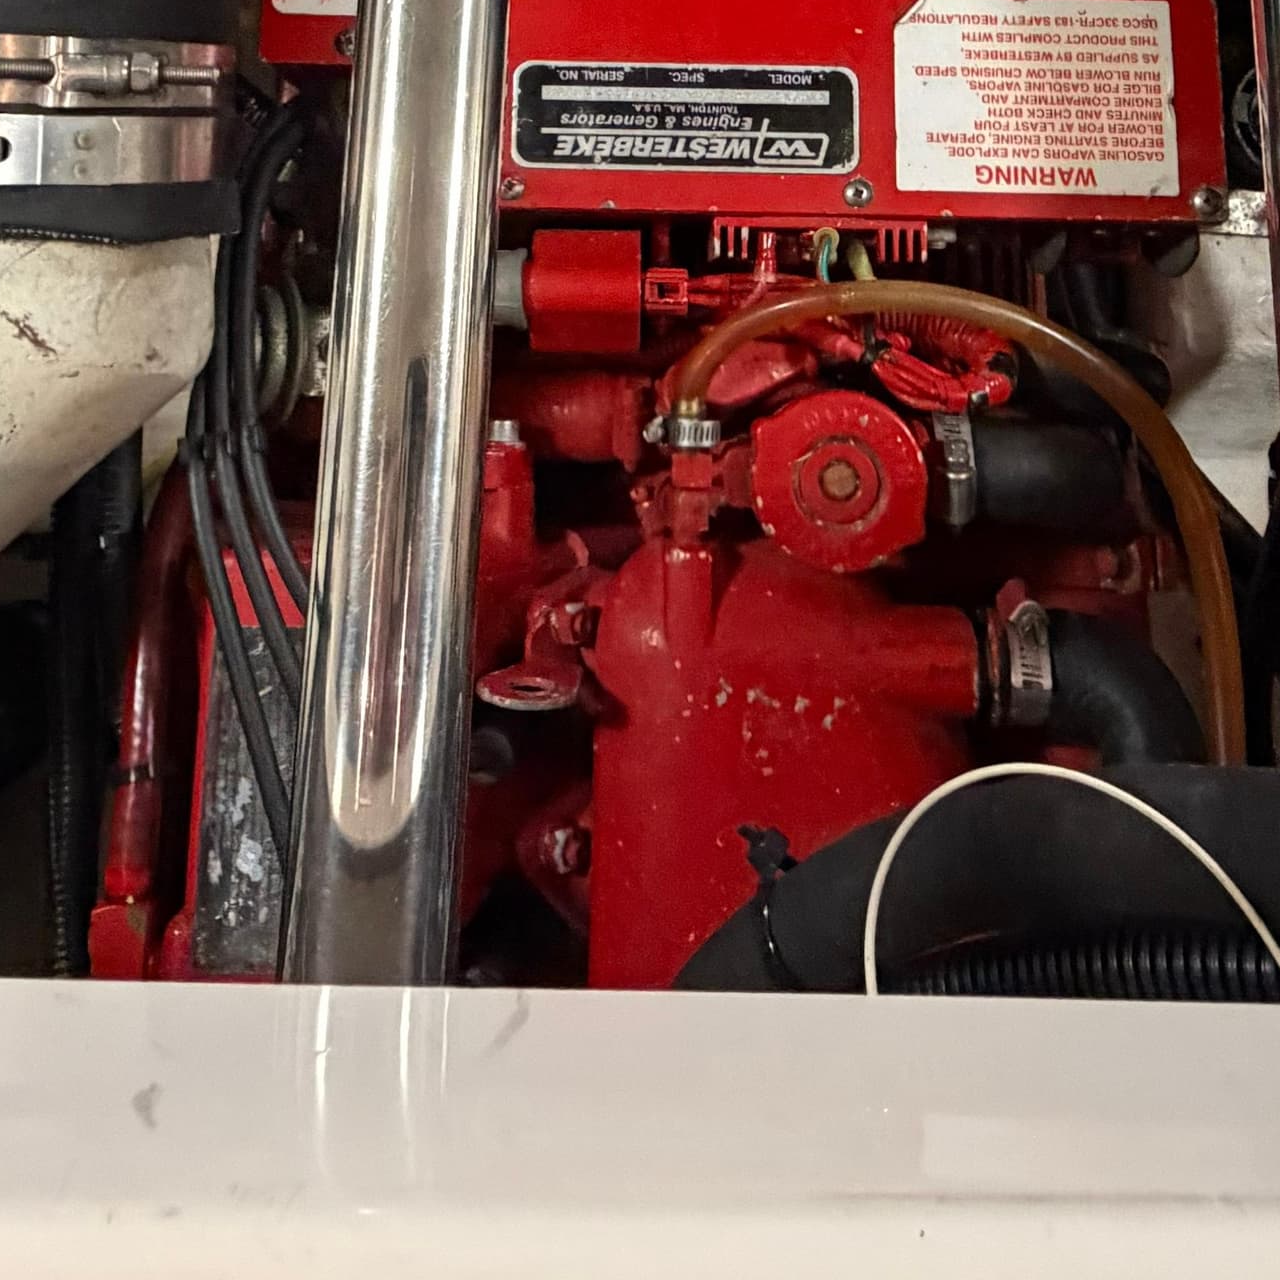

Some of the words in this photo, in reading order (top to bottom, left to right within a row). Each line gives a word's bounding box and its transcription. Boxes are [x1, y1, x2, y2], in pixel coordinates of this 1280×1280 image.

[1002, 16, 1050, 26] SAFETY
[1055, 17, 1119, 27] 33CFR-183
[1123, 18, 1158, 29] USCG
[962, 32, 993, 42] WITH
[996, 33, 1061, 44] COMPLIES
[1064, 35, 1125, 45] PRODUCT
[1130, 36, 1158, 46] THIS
[961, 48, 1053, 61] WESTERBEKE,
[1056, 52, 1072, 62] BY
[1076, 52, 1138, 63] SUPPLIED
[1142, 54, 1159, 64] AS
[556, 70, 578, 80] NO.
[581, 70, 624, 81] SERIAL
[912, 66, 957, 76] SPEED.
[961, 67, 1021, 78] CRUISING
[1027, 69, 1072, 79] BELOW
[1076, 70, 1130, 80] BLOWER
[1134, 71, 1160, 81] RUN
[669, 72, 704, 83] SPEC.
[768, 74, 812, 84] MODEL
[966, 80, 1021, 90] VAPORS.
[1024, 82, 1089, 92] GASOLINE
[1094, 84, 1119, 93] FOR
[1124, 84, 1161, 94] BILGE
[1012, 95, 1110, 106] COMPARTMENT
[1113, 98, 1162, 107] ENGINE
[632, 104, 661, 112] U.S.A.
[988, 108, 1023, 118] BOTH
[1027, 108, 1071, 118] CHECK
[1076, 110, 1101, 119] AND
[1106, 110, 1162, 121] MINUTES
[560, 113, 658, 128] Generators
[665, 115, 676, 128] &
[682, 115, 752, 130] Engines
[974, 120, 1009, 130] FOUR
[1014, 122, 1055, 132] LEAST
[1059, 123, 1074, 132] AT
[1079, 123, 1104, 132] FOR
[1108, 124, 1163, 134] BLOWER
[926, 132, 985, 144] OPERATE
[989, 133, 1040, 145] ENGINE,
[1045, 136, 1107, 147] STARTING
[1112, 137, 1164, 148] BEFORE
[553, 135, 750, 159] WESTERBEKE
[944, 147, 1008, 158] EXPLODE.
[1012, 148, 1039, 158] CAN
[1043, 149, 1095, 159] VAPORS
[1098, 150, 1164, 161] GASOLINE
[975, 165, 1097, 187] WARNING
